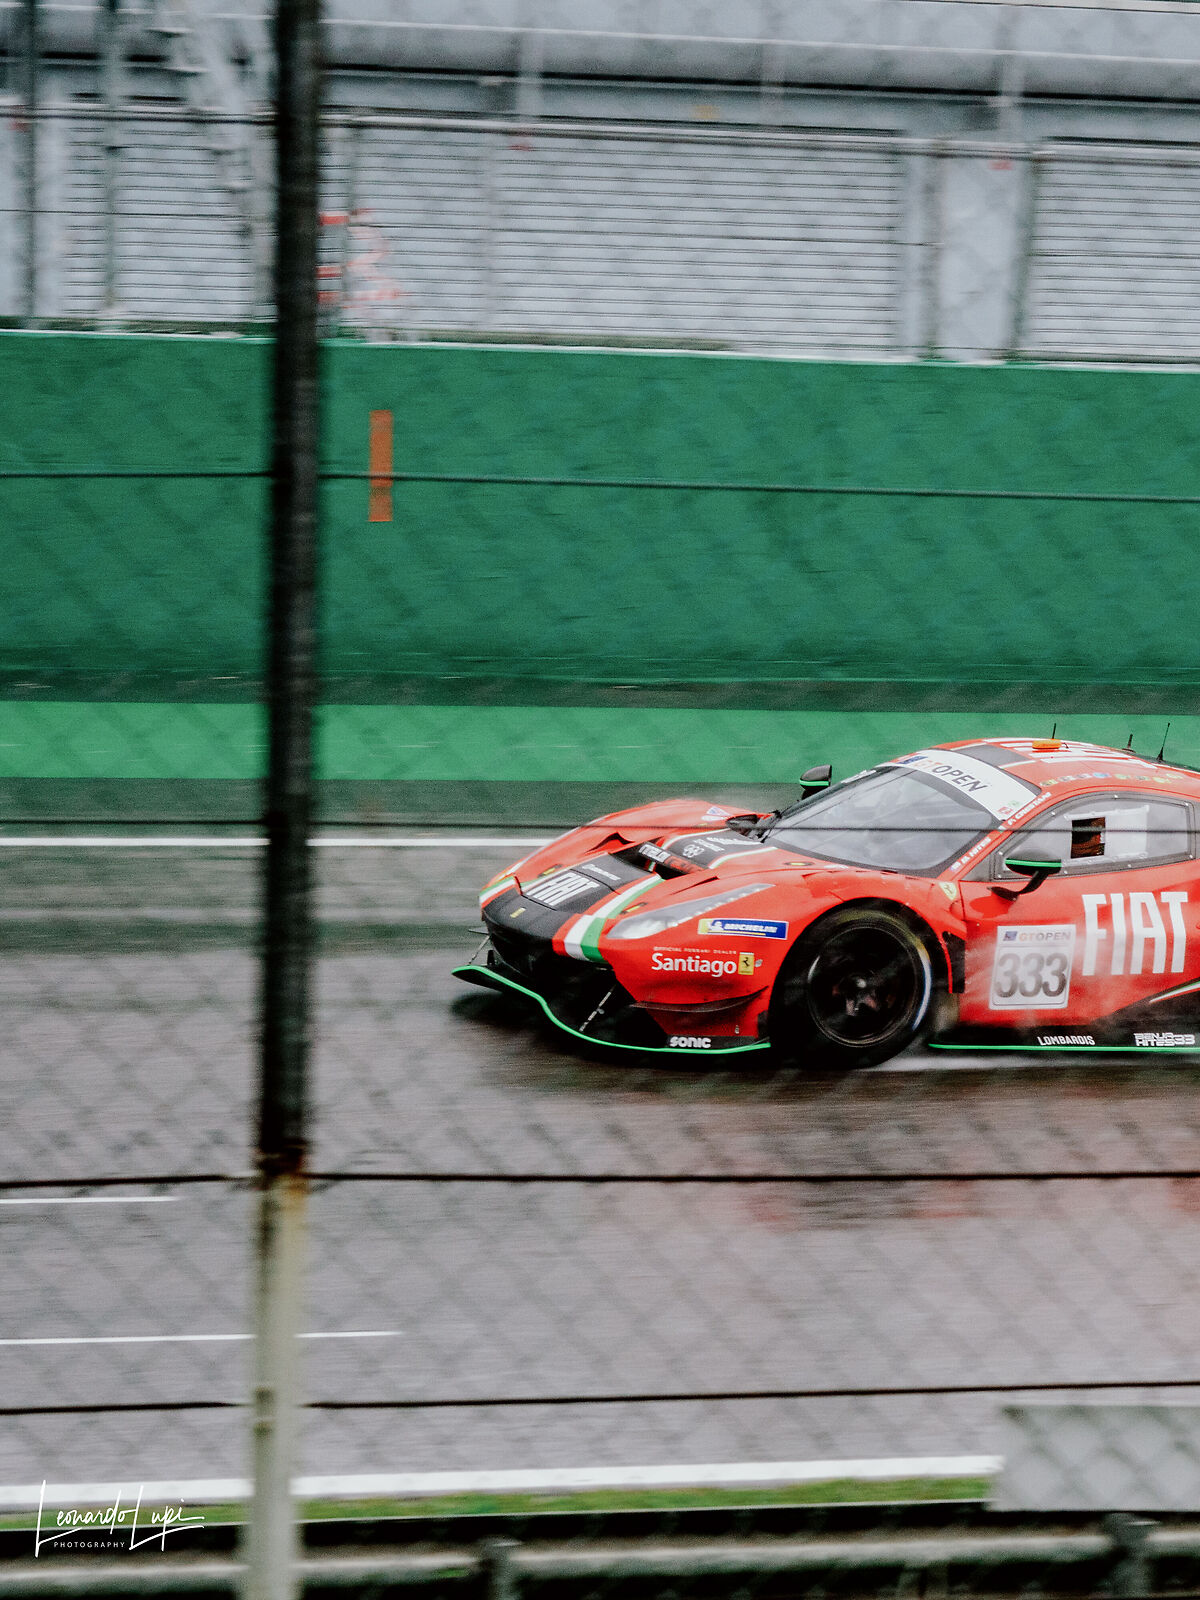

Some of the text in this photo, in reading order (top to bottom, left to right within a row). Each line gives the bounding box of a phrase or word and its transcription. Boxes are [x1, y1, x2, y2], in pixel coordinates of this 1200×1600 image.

[526, 871, 600, 906] FIAT
[1081, 891, 1189, 976] FIAT
[651, 952, 738, 978] Santiago
[994, 952, 1068, 998] 333
[1037, 1035, 1096, 1046] LOMBARDIS
